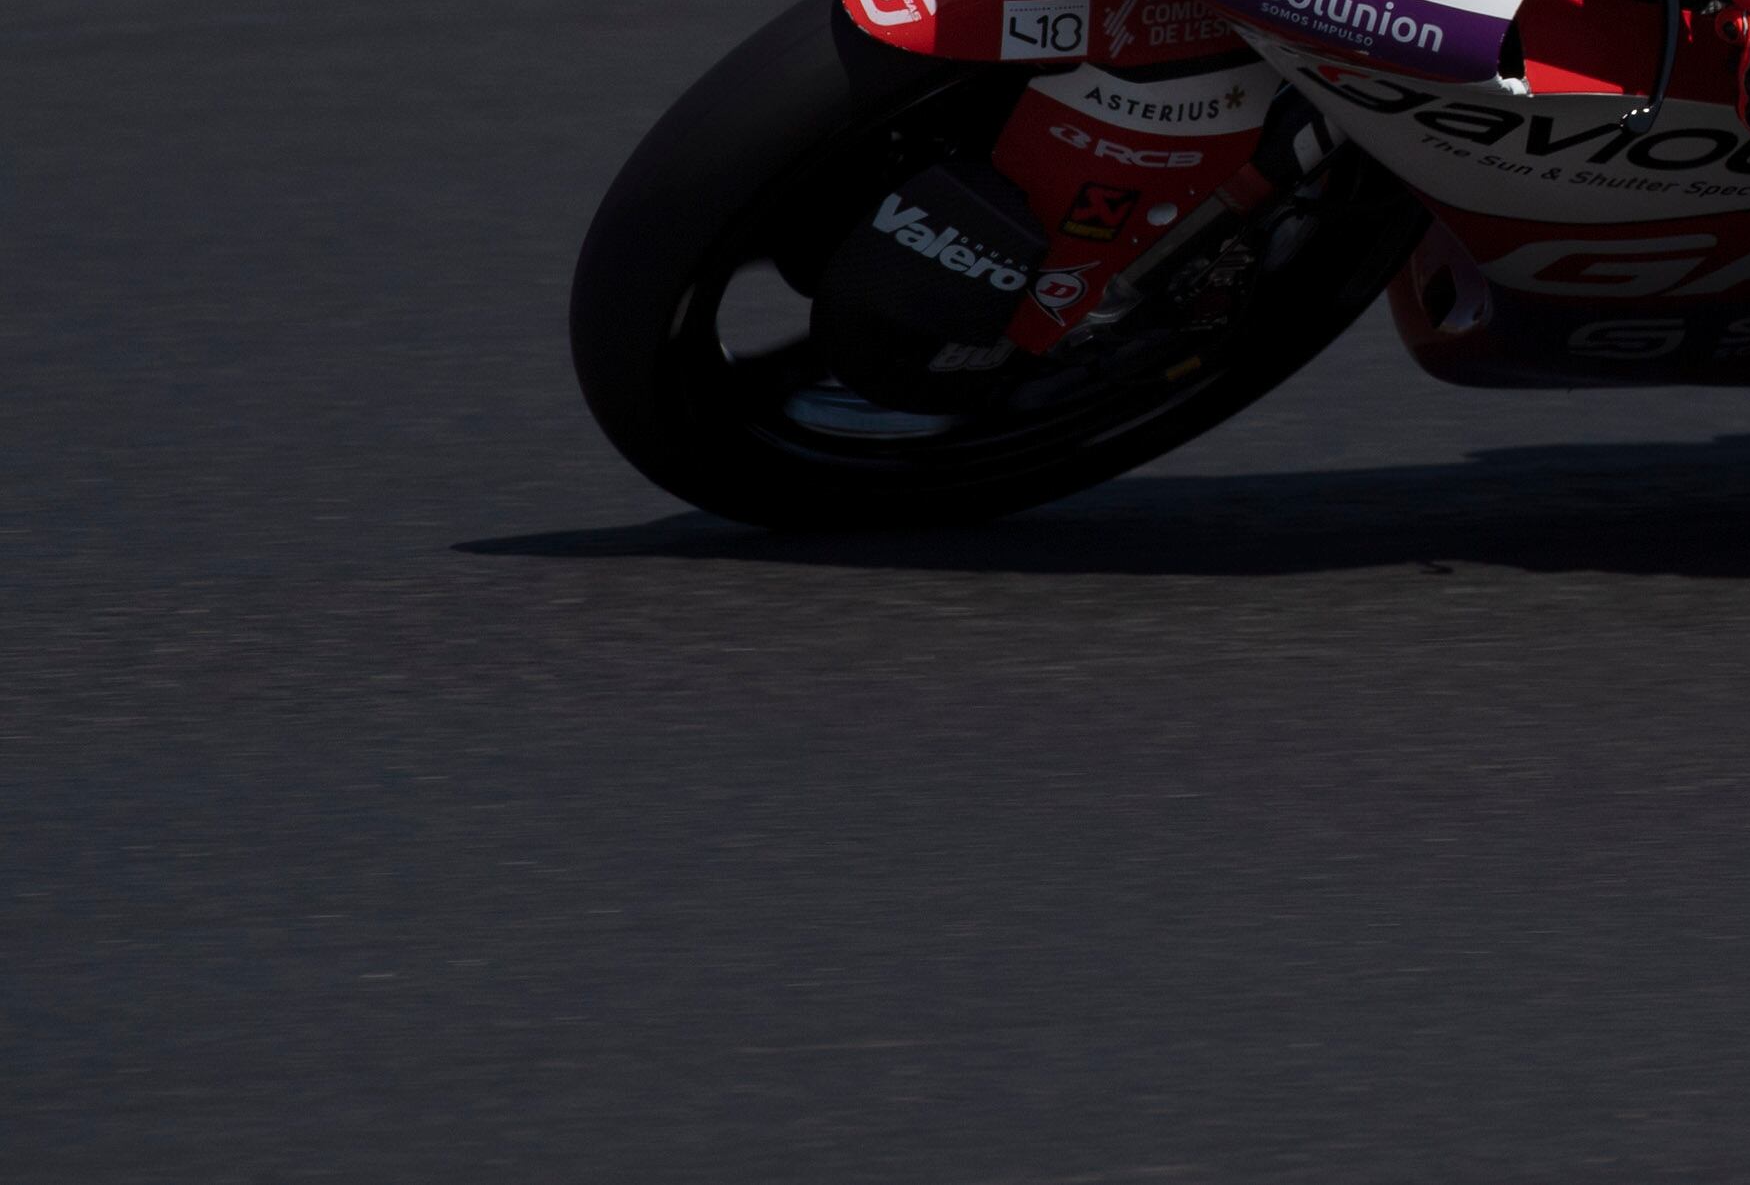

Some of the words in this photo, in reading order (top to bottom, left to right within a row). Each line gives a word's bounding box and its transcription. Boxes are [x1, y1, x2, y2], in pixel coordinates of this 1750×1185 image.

[1260, 1, 1311, 29] SOMOS
[1312, 19, 1375, 49] IMPULSO
[1084, 87, 1220, 122] ASTERIUS
[1421, 133, 1472, 157] The
[1479, 152, 1533, 178] Sun
[1542, 164, 1559, 180] &
[1569, 170, 1679, 196] Shutter
[872, 192, 1028, 292] Valero
